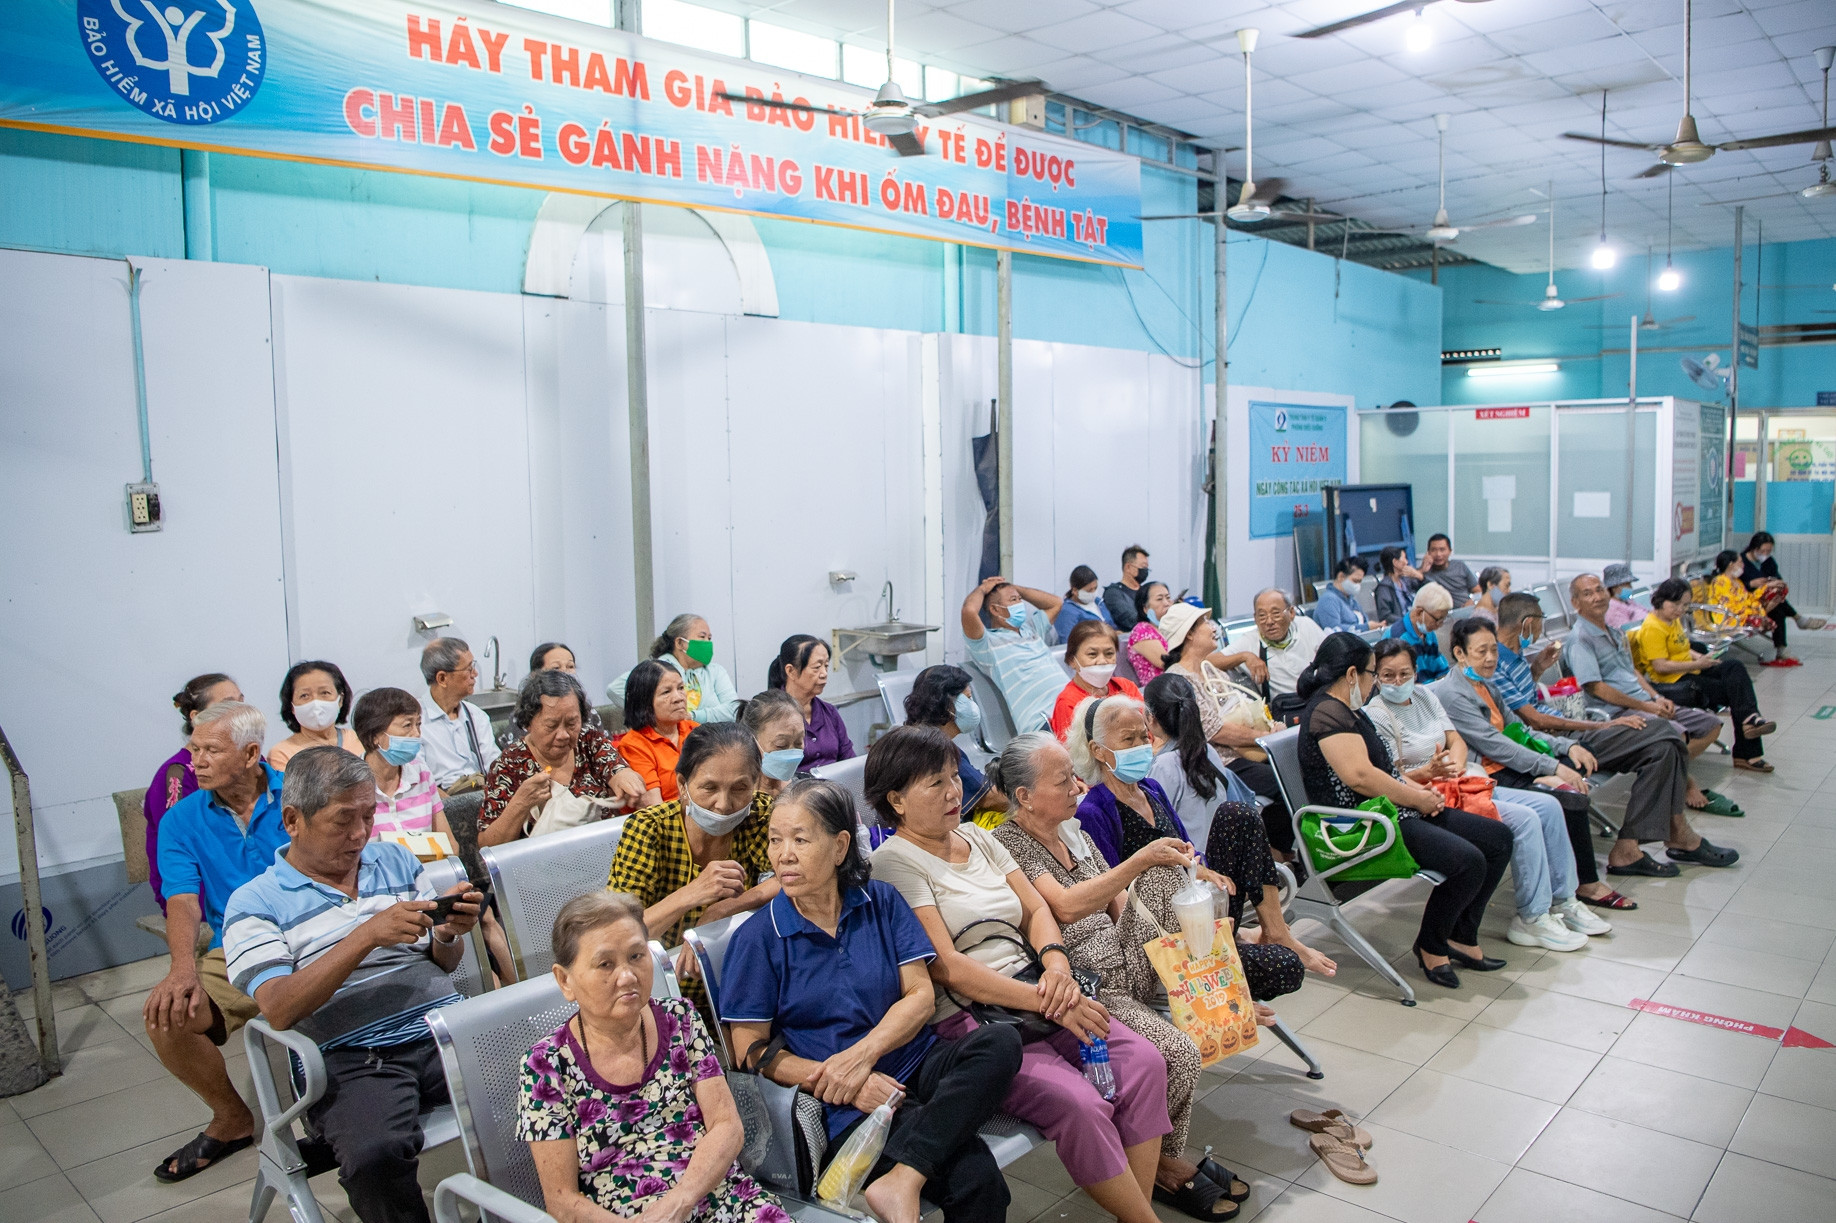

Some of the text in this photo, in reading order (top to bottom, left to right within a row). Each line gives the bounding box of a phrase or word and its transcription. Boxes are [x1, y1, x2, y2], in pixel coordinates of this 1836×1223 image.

[83, 16, 262, 122] BẢO HIỂM XÃ HỘI VIỆT NAM
[406, 14, 509, 73] HÃY
[523, 38, 651, 101] THAM
[664, 69, 734, 117] GIA
[745, 82, 815, 133] BẢO
[938, 124, 967, 165] TẾ
[975, 131, 1008, 173] ĐỂ
[1014, 146, 1076, 192] ĐƯỢC
[343, 87, 1108, 251] CHIA SẺ GÁNH NẶNG KHI ỐM ĐAU, BỆNH TẬT
[1295, 441, 1329, 466] NIỆM
[1179, 964, 1243, 1003] HALLOWEEN
[1188, 957, 1215, 973] HAPPY
[1203, 991, 1227, 1010] 2019
